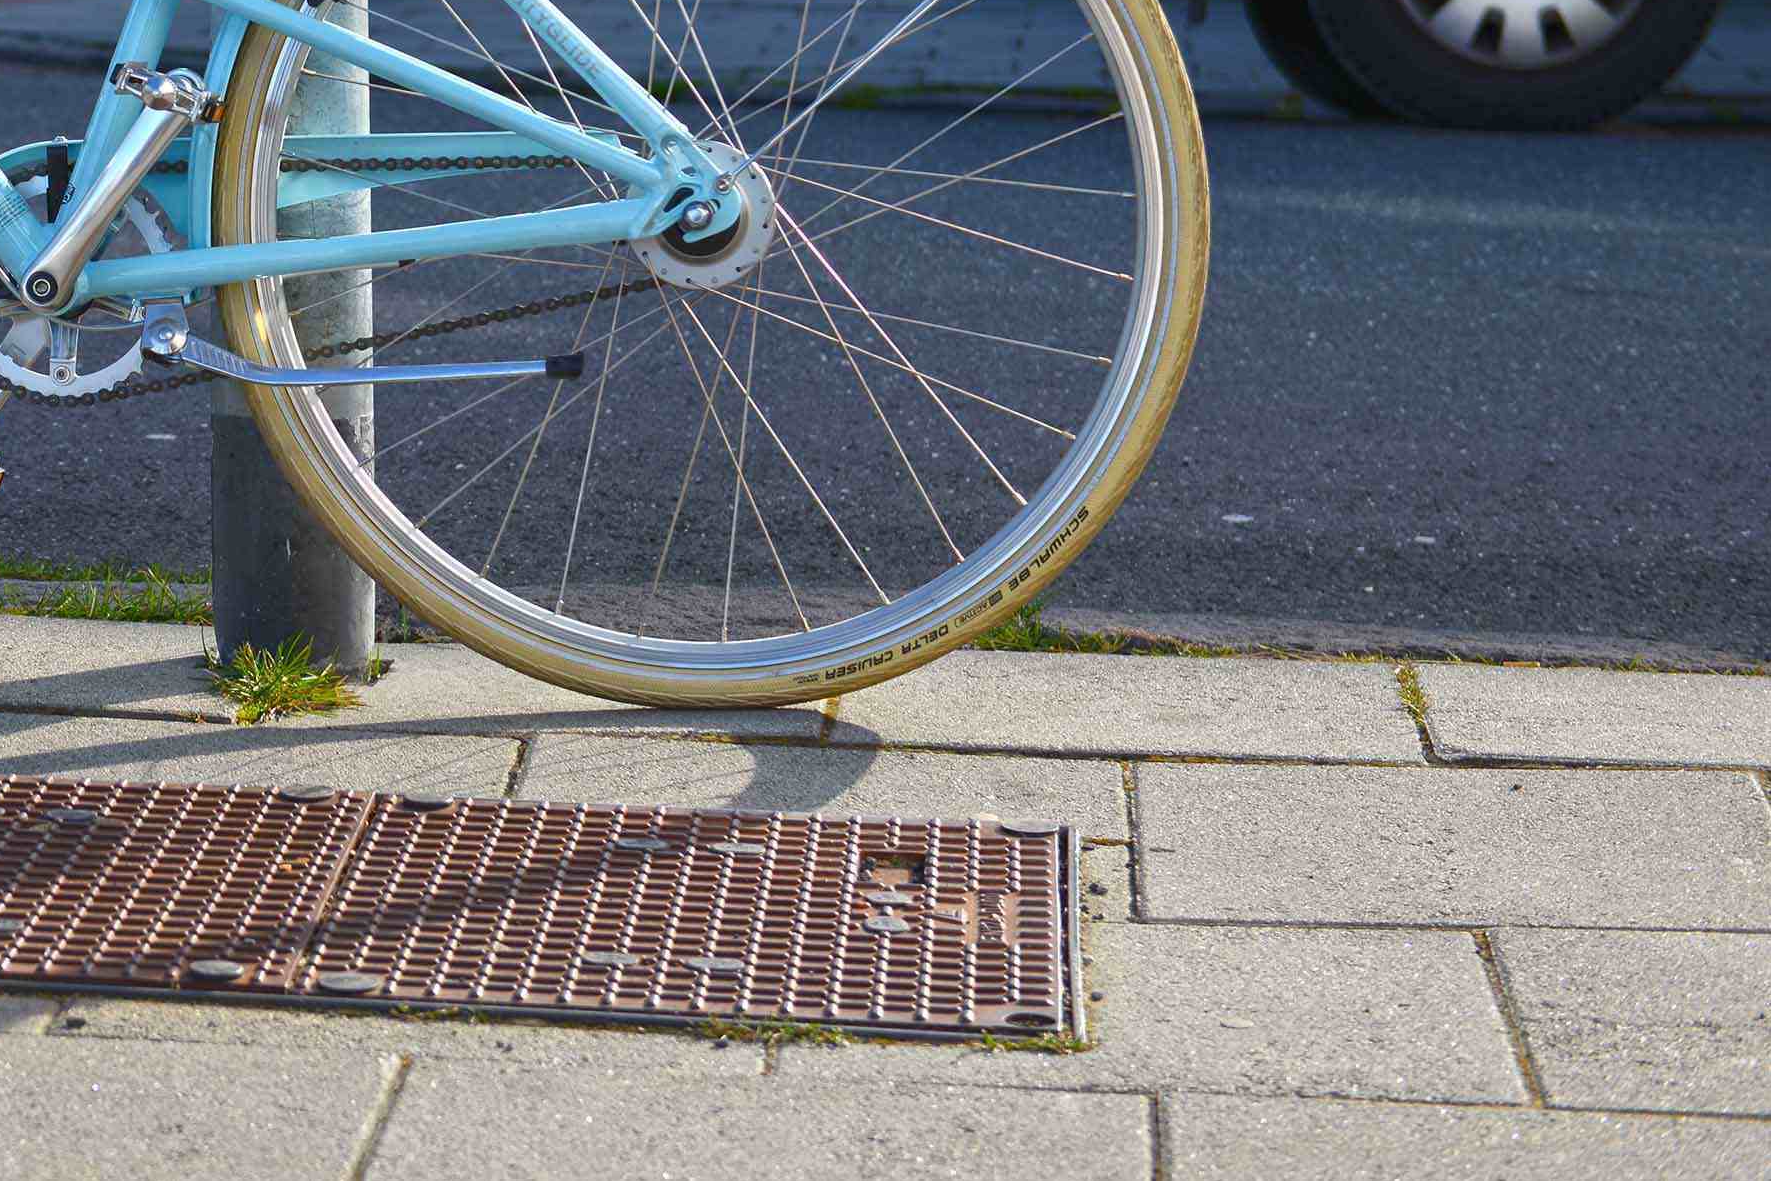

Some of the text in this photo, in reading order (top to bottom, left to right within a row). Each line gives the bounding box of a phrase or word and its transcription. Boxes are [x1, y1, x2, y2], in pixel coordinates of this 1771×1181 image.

[1008, 506, 1089, 592] SCHWALBE
[901, 624, 949, 655] DELTA
[825, 649, 894, 680] CRUISER
